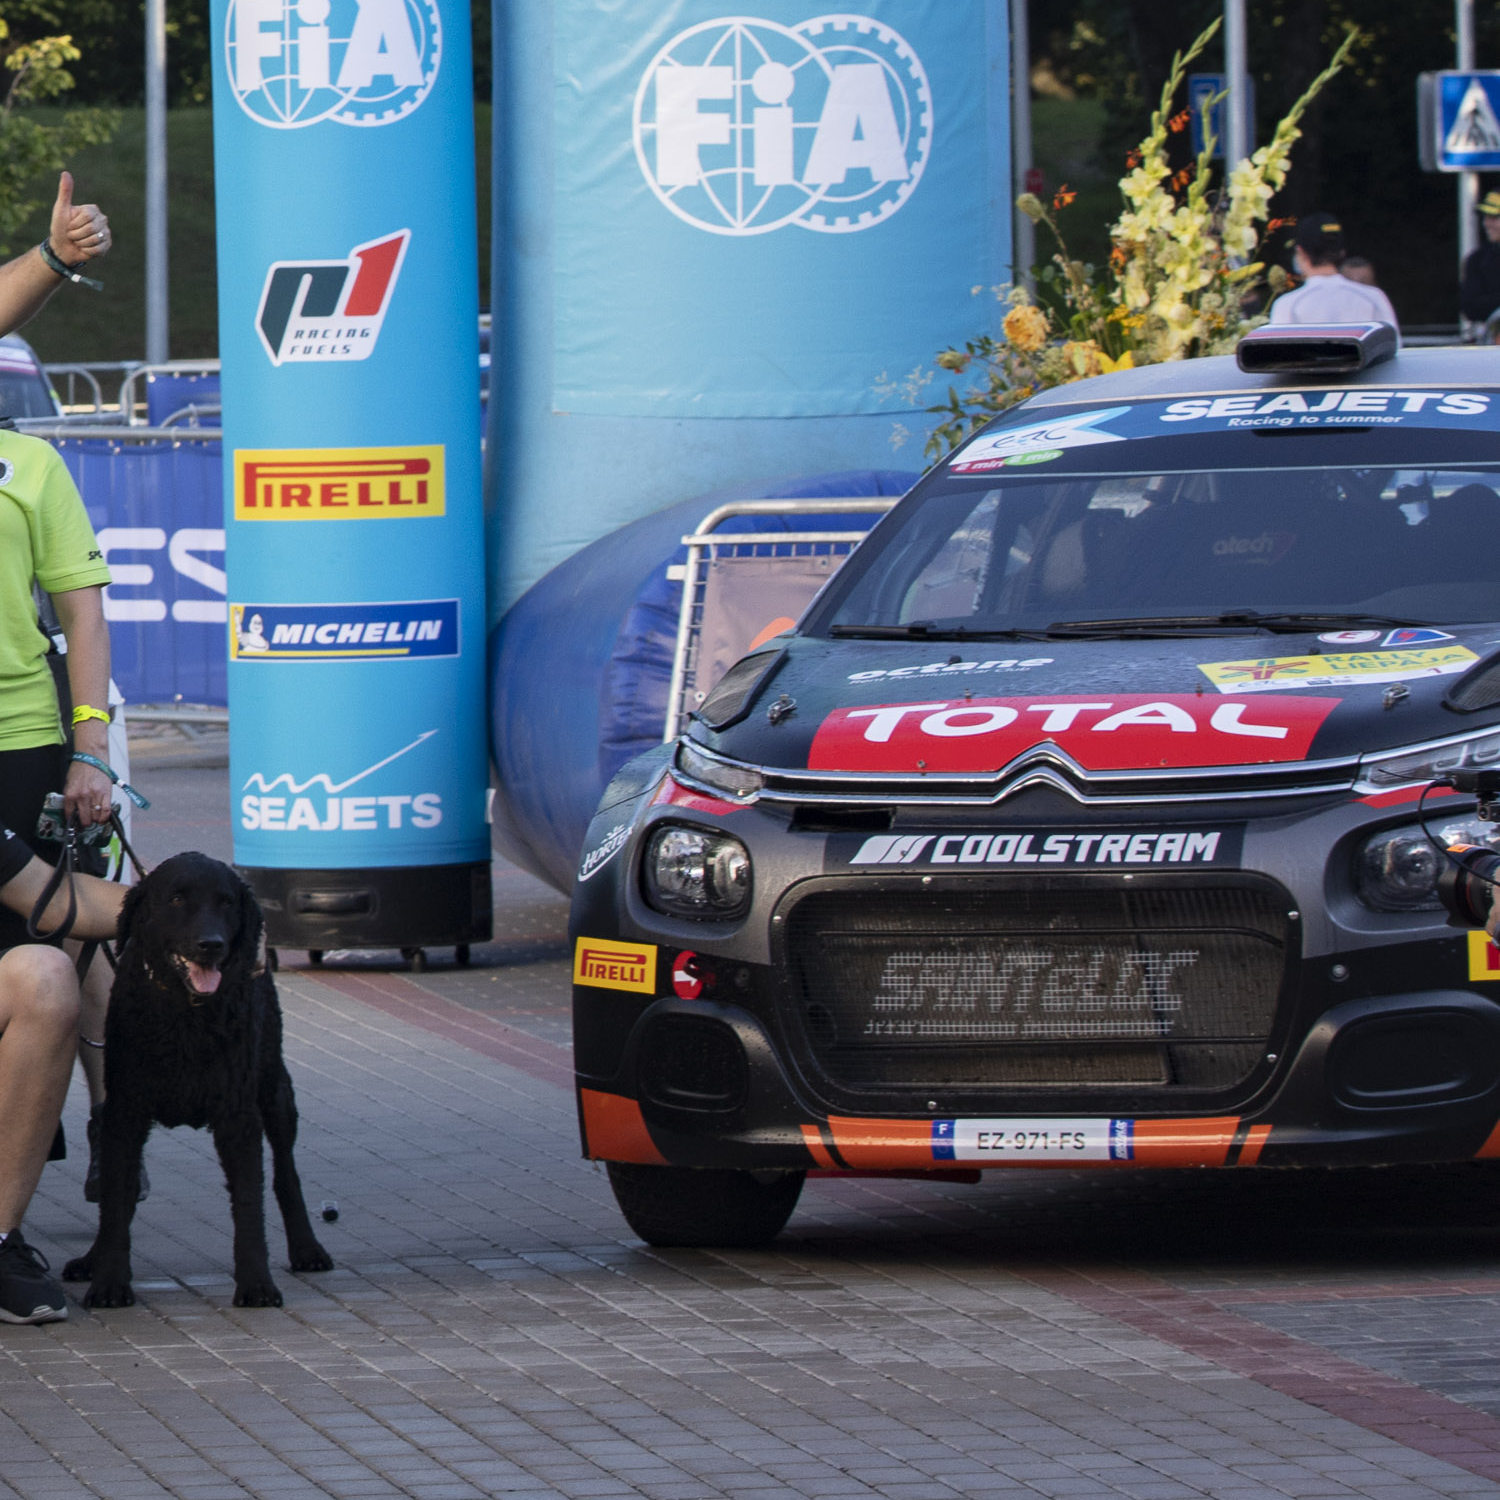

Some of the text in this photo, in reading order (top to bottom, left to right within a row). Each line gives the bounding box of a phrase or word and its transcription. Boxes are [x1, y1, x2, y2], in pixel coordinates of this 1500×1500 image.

[293, 327, 371, 341] RACING
[289, 343, 353, 356] FUELS
[1158, 391, 1491, 424] SEAJETS
[1227, 413, 1404, 429] Racing to summer
[971, 459, 1005, 471] min
[1025, 450, 1061, 462] min
[242, 456, 432, 509] PIRELLI
[270, 618, 443, 645] MICHELIN
[846, 657, 1056, 681] octane
[1322, 651, 1429, 664] RALLY
[846, 701, 1291, 744] TOTAL
[240, 791, 443, 832] SEAJETS
[930, 832, 1222, 863] COOLSTREAM
[581, 948, 648, 985] PIRELLI
[939, 1123, 1086, 1151] F EZ-971-FS
